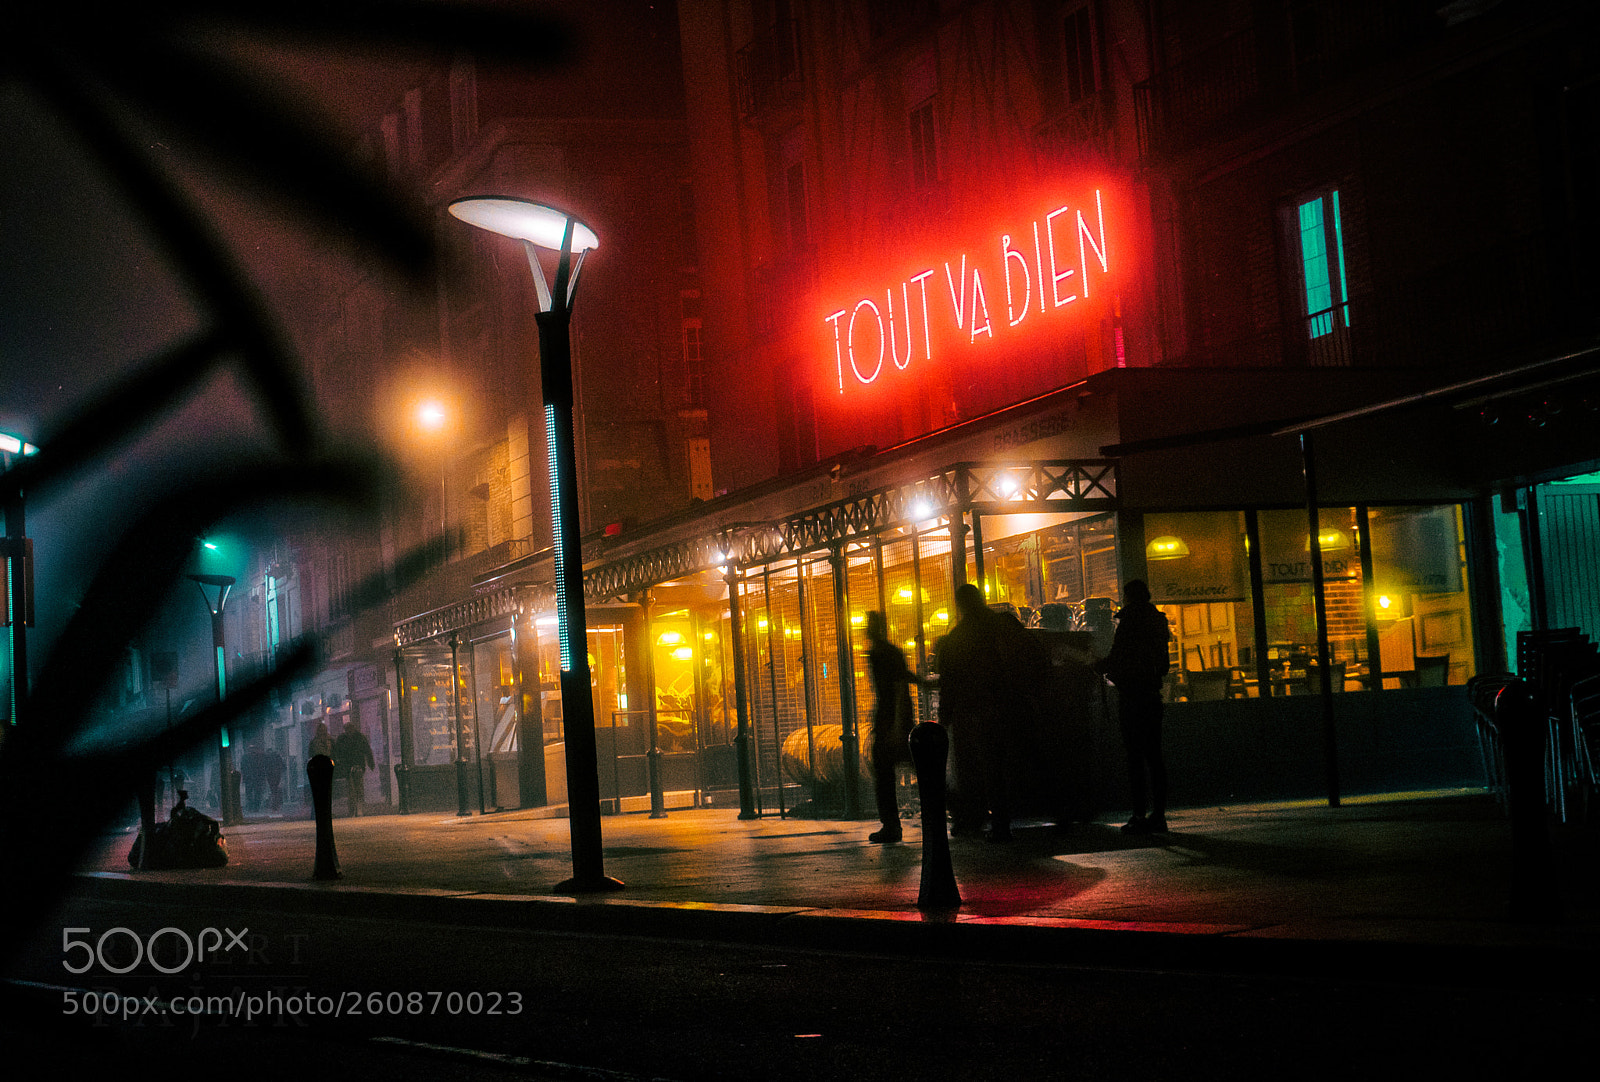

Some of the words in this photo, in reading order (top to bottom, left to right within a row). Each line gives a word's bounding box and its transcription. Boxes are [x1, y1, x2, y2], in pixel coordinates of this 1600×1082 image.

[824, 269, 934, 395] TOUT
[944, 253, 993, 345] VA
[1001, 188, 1109, 327] BIEN
[1268, 561, 1307, 576] TOUT
[1165, 582, 1229, 597] Brasserie
